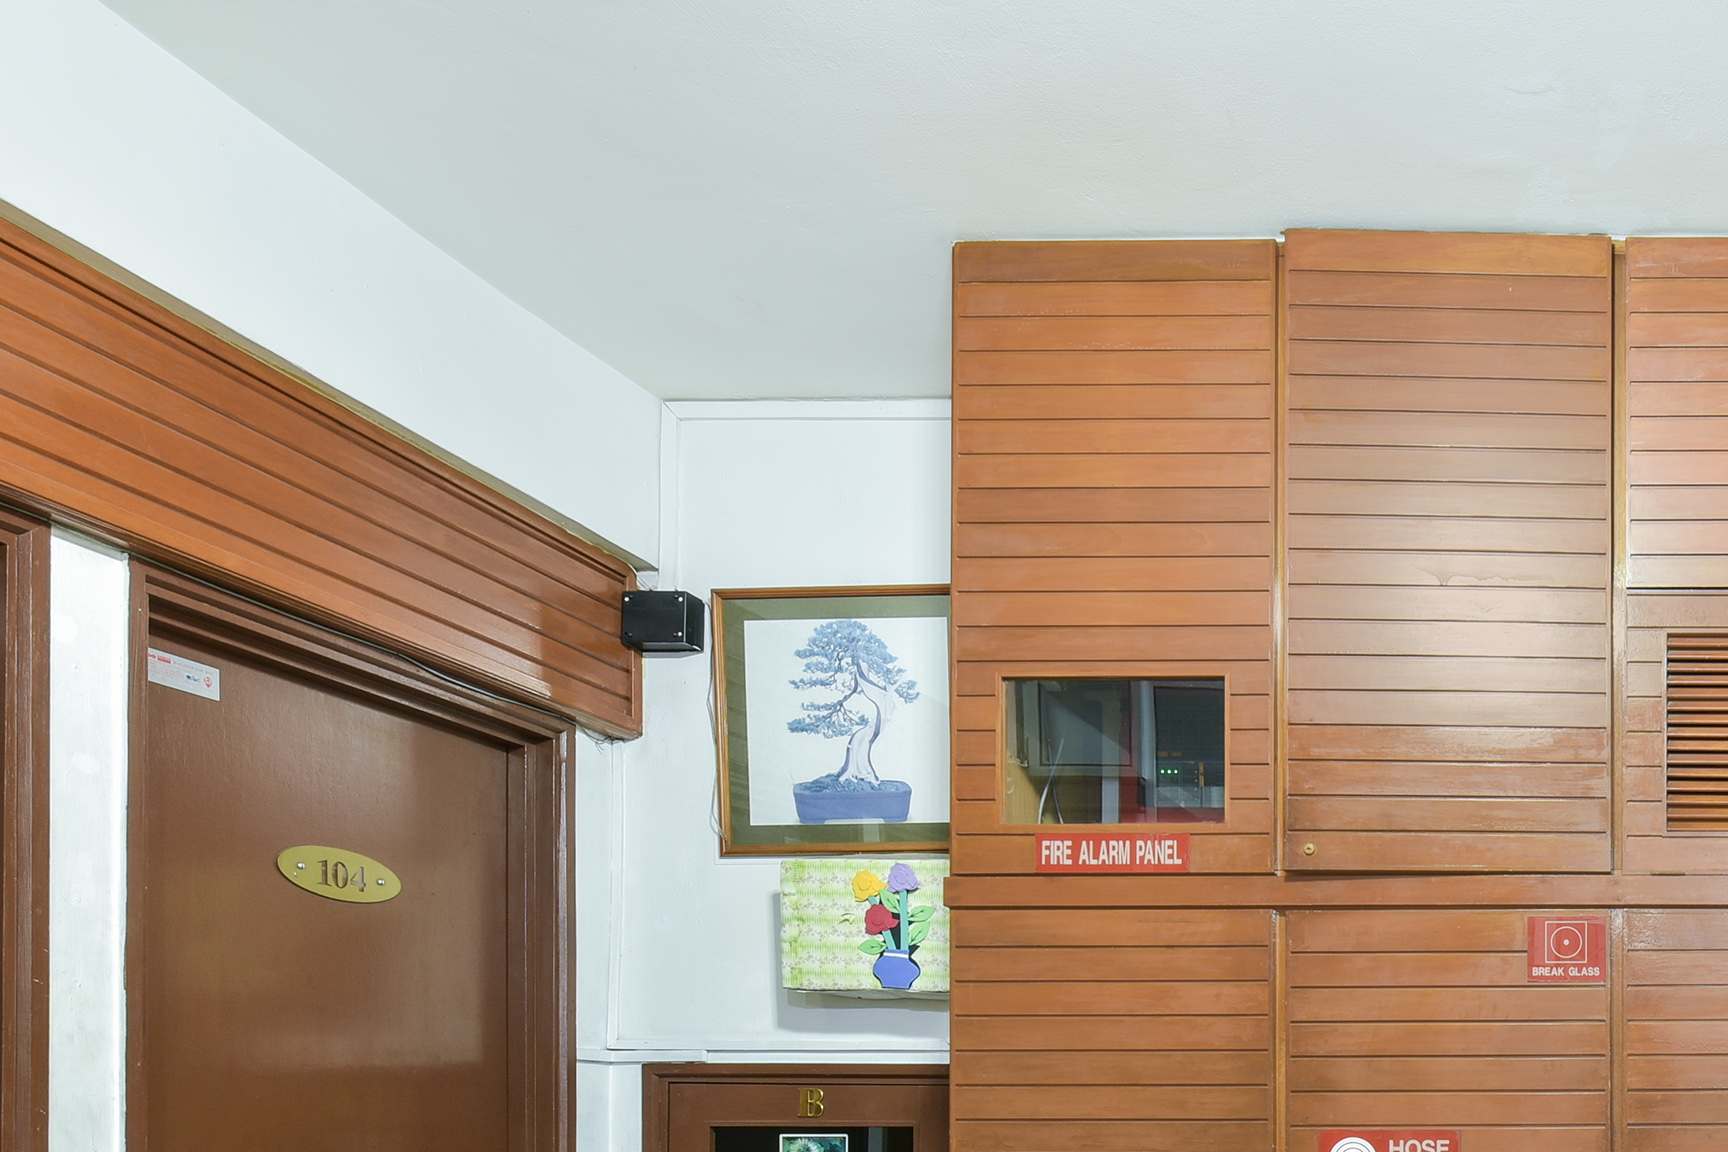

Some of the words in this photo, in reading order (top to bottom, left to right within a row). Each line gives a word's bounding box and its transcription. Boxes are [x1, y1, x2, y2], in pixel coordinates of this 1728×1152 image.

[1041, 840, 1073, 865] FIRE
[1078, 839, 1131, 865] ALARM
[1135, 839, 1183, 865] PANEL
[316, 859, 367, 893] 104
[1531, 966, 1565, 977] BREAK
[1568, 966, 1601, 977] GLASS
[798, 1087, 824, 1118] B
